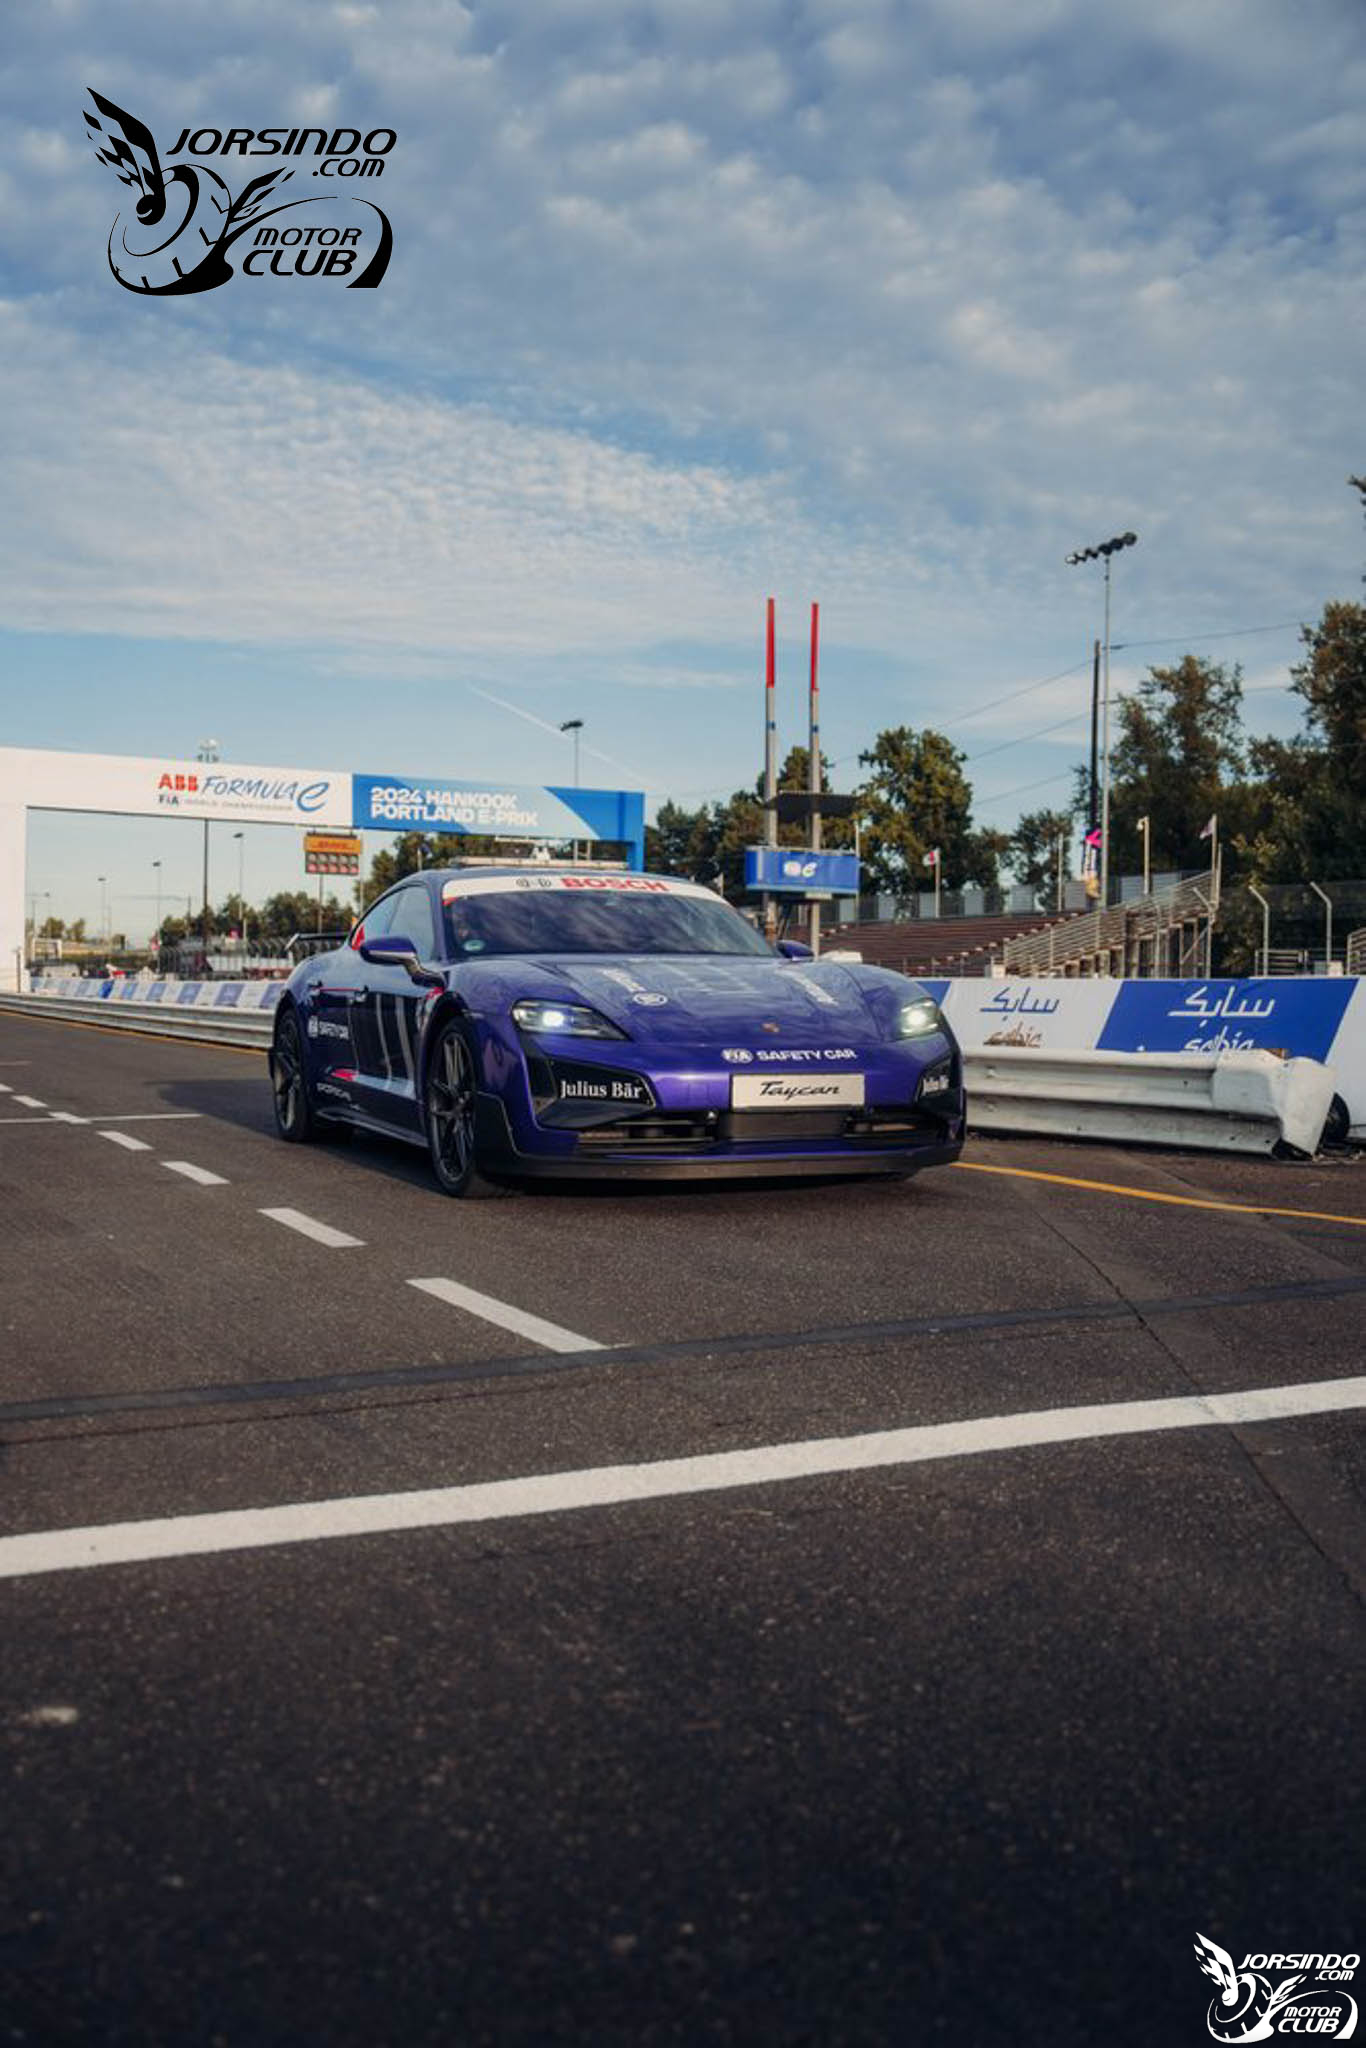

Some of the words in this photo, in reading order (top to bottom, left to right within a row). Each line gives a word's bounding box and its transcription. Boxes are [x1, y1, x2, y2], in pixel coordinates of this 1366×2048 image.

[158, 773, 198, 792] ABB
[371, 787, 422, 804] 2024
[425, 789, 517, 809] HANKOOK
[371, 803, 475, 823] PORTLAND
[478, 809, 538, 827] E-PRIX
[561, 877, 670, 892] BOSCH
[756, 1049, 821, 1061] SAFETY
[823, 1048, 857, 1060] CAR
[561, 1081, 607, 1099] Julius
[611, 1081, 643, 1099] Bär
[760, 1081, 840, 1100] Taycan
